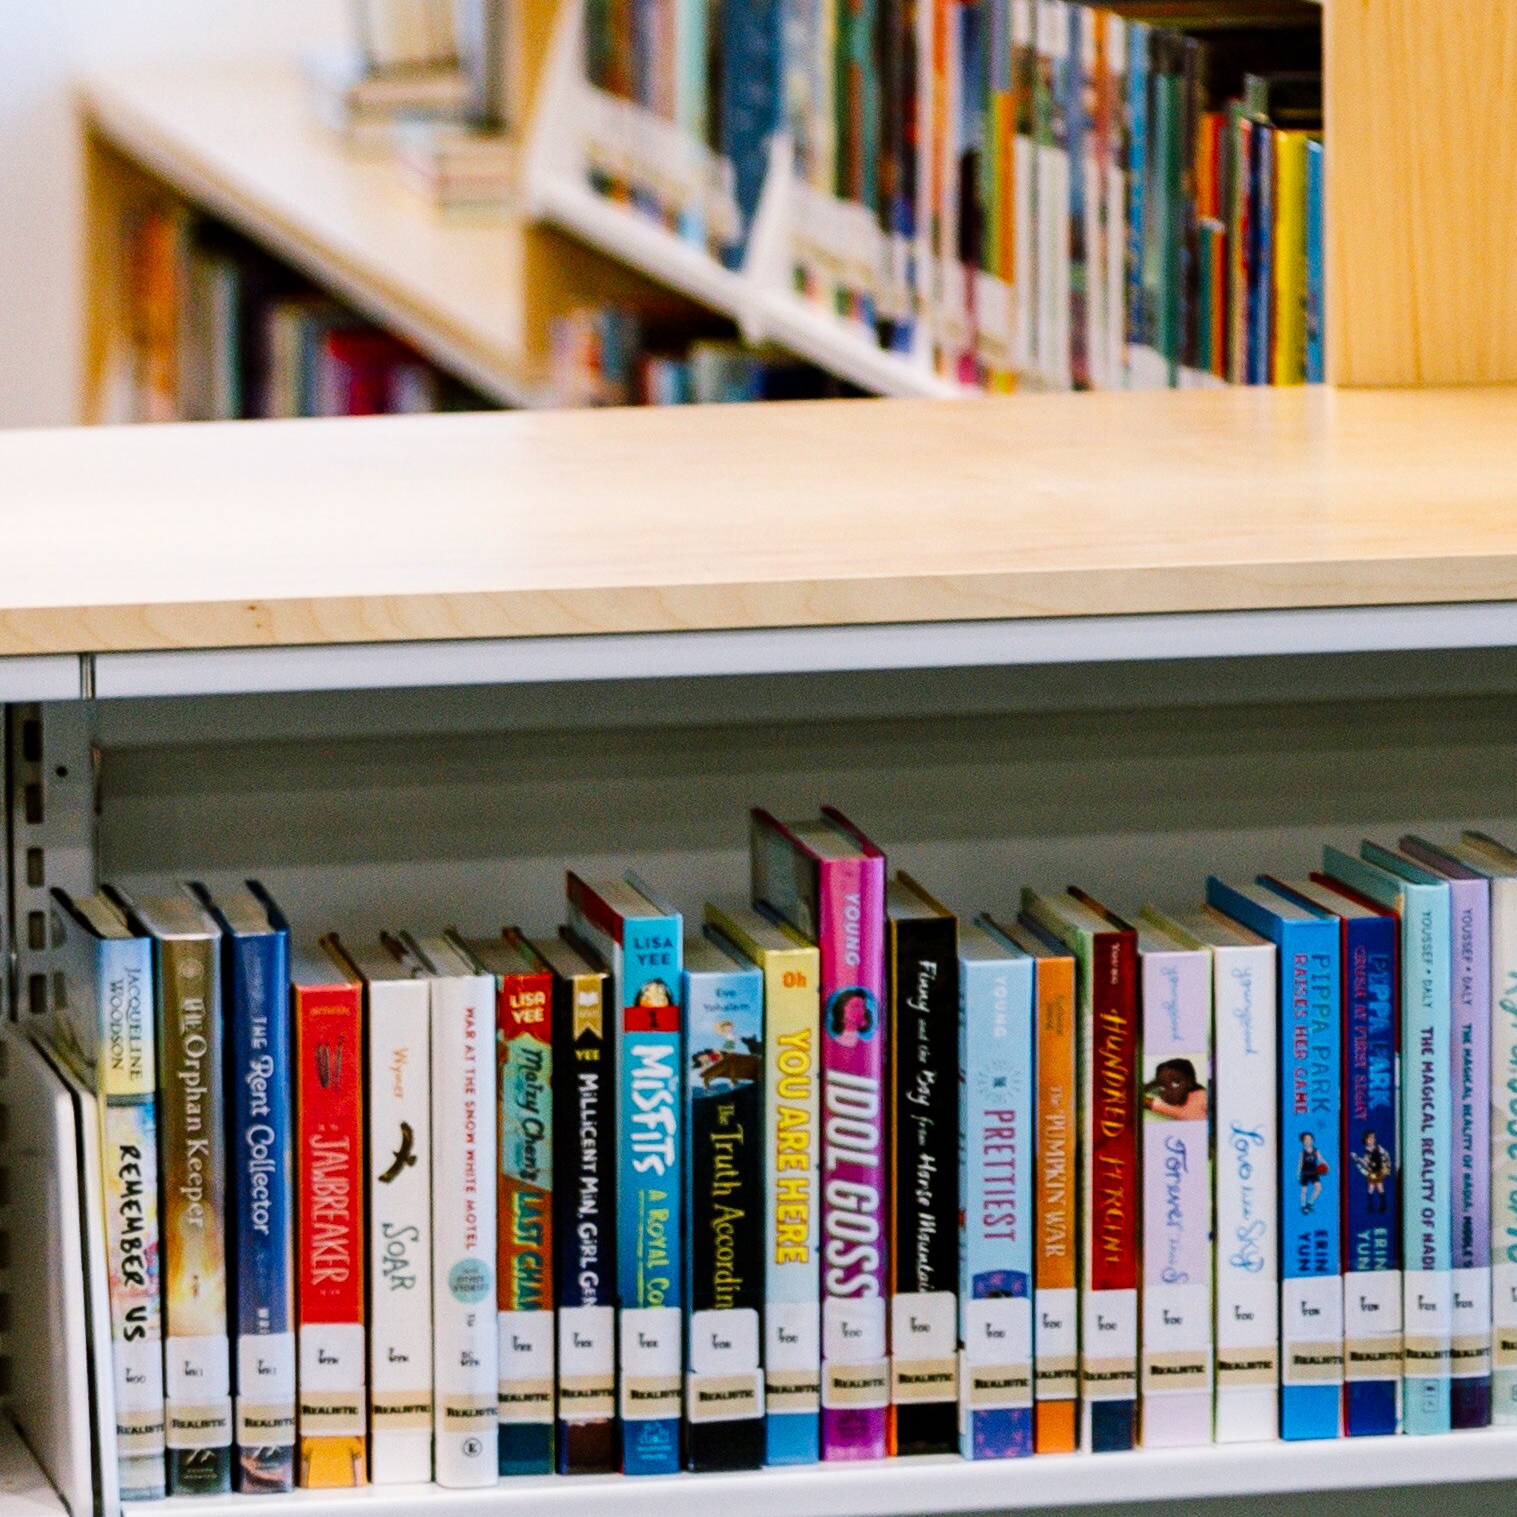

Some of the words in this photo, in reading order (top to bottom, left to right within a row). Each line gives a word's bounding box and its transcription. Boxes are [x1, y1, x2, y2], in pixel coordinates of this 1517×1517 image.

[844, 892, 861, 968] YOUNG
[1420, 911, 1433, 968] YOUSSEF
[1461, 908, 1474, 970] YOUSSEF
[637, 952, 672, 966] YEE
[783, 971, 807, 988] Oh
[509, 991, 546, 1009] LISA
[1294, 953, 1308, 1019] RAISES
[1312, 953, 1331, 1034] PIPPA
[1367, 953, 1391, 1034] PIPPA
[1421, 979, 1433, 1009] DALY
[1462, 976, 1474, 1006] DALY
[109, 979, 125, 1070] WOODSON
[124, 967, 143, 1082] JACQUELINE
[252, 1016, 268, 1050] THE
[465, 1006, 476, 1039] WAR
[511, 1007, 545, 1024] YEE
[649, 1012, 659, 1028] 1
[1461, 1022, 1473, 1044] THE
[465, 1045, 476, 1063] AT
[575, 1049, 600, 1062] YEE
[776, 1028, 812, 1100] YOU
[1294, 1025, 1308, 1060] HER
[1420, 1027, 1434, 1056] THE
[178, 1035, 208, 1132] Orphan
[246, 1055, 274, 1117] Rent
[465, 1067, 476, 1094] THE
[906, 1069, 938, 1107] Boy
[1098, 1009, 1127, 1138] HUNDRED
[1294, 1067, 1309, 1115] GAME
[1312, 1045, 1331, 1114] PARK
[1368, 1040, 1391, 1109] PARK
[1461, 1048, 1474, 1101] MAGICAL
[1420, 1060, 1435, 1133] MAGICAL
[465, 1099, 476, 1145] SNOW
[775, 1106, 810, 1172] ARE
[824, 1069, 880, 1171] IDOL
[1461, 1107, 1473, 1151] REALITY
[245, 1125, 276, 1235] Collector
[465, 1150, 477, 1193] WHITE
[710, 1124, 745, 1197] Truth
[914, 1152, 938, 1207] Horse
[982, 1110, 1017, 1241] PRETTIEST
[1042, 1112, 1067, 1204] PUMPKIN
[1420, 1138, 1435, 1203] REALITY
[1462, 1154, 1473, 1169] OF
[180, 1138, 209, 1228] Keeper
[649, 1189, 668, 1201] A
[118, 1145, 145, 1287] REMEMBER
[308, 1134, 350, 1285] JAWBREAKER
[466, 1200, 478, 1251] MOTEL
[511, 1191, 544, 1247] LAST
[774, 1178, 810, 1265] HERE
[1420, 1208, 1435, 1229] OF
[381, 1221, 420, 1291] SOAR
[647, 1207, 671, 1269] ROYAL
[823, 1179, 880, 1298] GOSS
[1044, 1210, 1067, 1258] WAR
[1297, 1231, 1311, 1272] YUN
[1315, 1229, 1328, 1273] ERIN
[1356, 1230, 1370, 1270] YUN
[1374, 1227, 1388, 1271] ERIN
[1421, 1234, 1436, 1270] NADI
[123, 1305, 148, 1342] US
[832, 1377, 885, 1388] REALISTIC
[899, 1373, 953, 1384] REALISTIC
[974, 1378, 1028, 1389] REALISTIC
[1151, 1364, 1204, 1375] REALISTIC
[1218, 1360, 1272, 1370] REALISTIC
[302, 1404, 358, 1415] REALISTIC
[374, 1403, 430, 1414] REALISTIC
[699, 1388, 754, 1400] REALISTIC
[172, 1418, 227, 1429] REALISTIC
